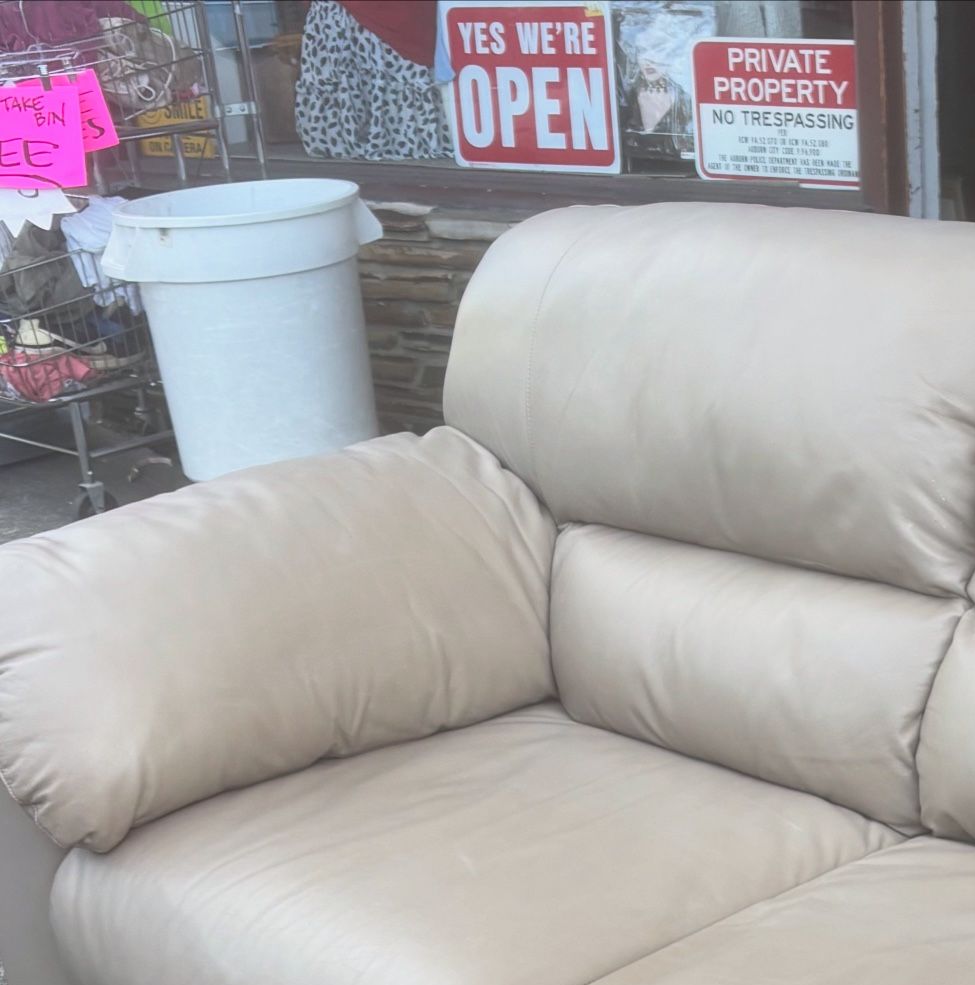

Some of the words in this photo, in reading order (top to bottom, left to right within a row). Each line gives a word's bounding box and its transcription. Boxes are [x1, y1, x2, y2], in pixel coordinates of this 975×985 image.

[457, 21, 506, 55] YES
[515, 21, 597, 55] WE'RE
[727, 47, 833, 75] PRIVATE
[0, 95, 44, 112] TAKE
[713, 76, 849, 105] PROPERTY
[34, 102, 65, 127] BIN
[458, 64, 609, 151] OPEN
[712, 109, 735, 125] NO
[741, 110, 855, 130] TRESPASSING
[0, 138, 59, 167] EE
[164, 142, 202, 154] CAERA
